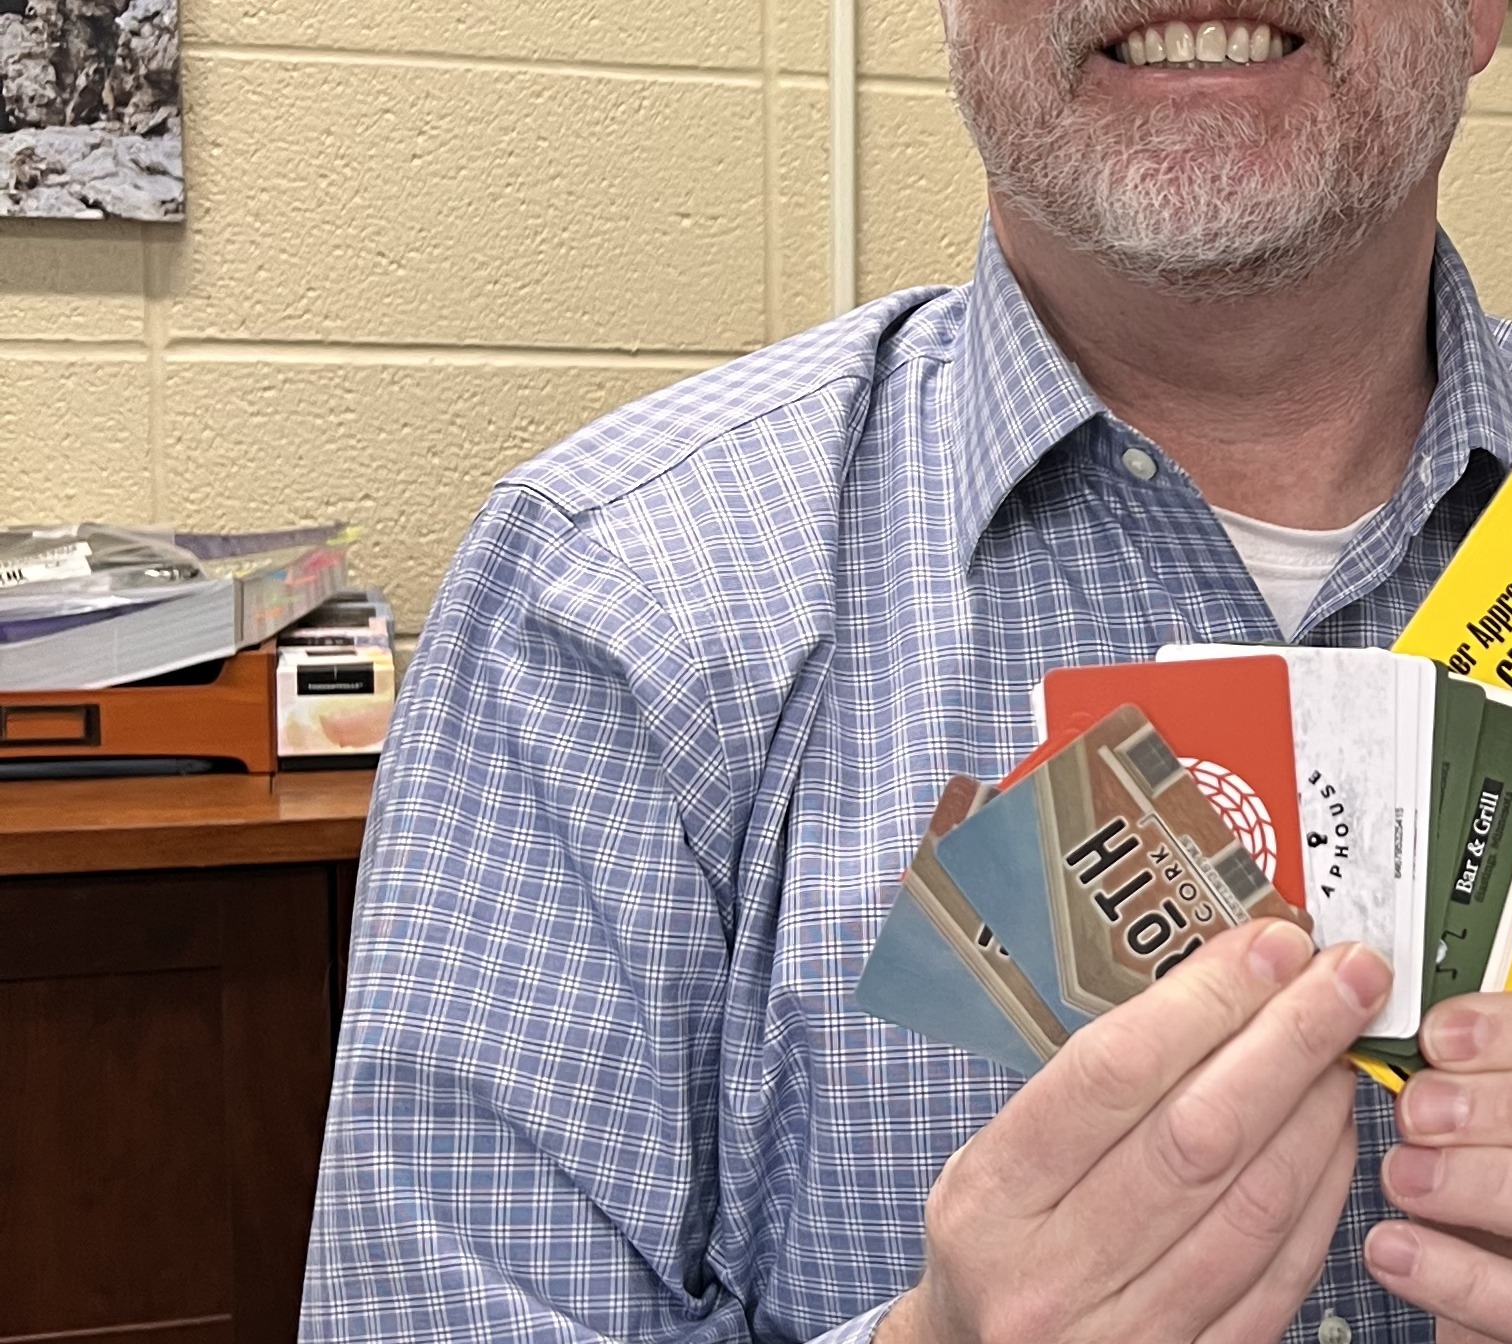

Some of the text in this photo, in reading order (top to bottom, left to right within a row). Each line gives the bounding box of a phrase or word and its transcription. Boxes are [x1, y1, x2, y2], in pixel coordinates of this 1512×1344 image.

[1150, 844, 1213, 922] CORK
[1455, 791, 1499, 894] Bar & Grill
